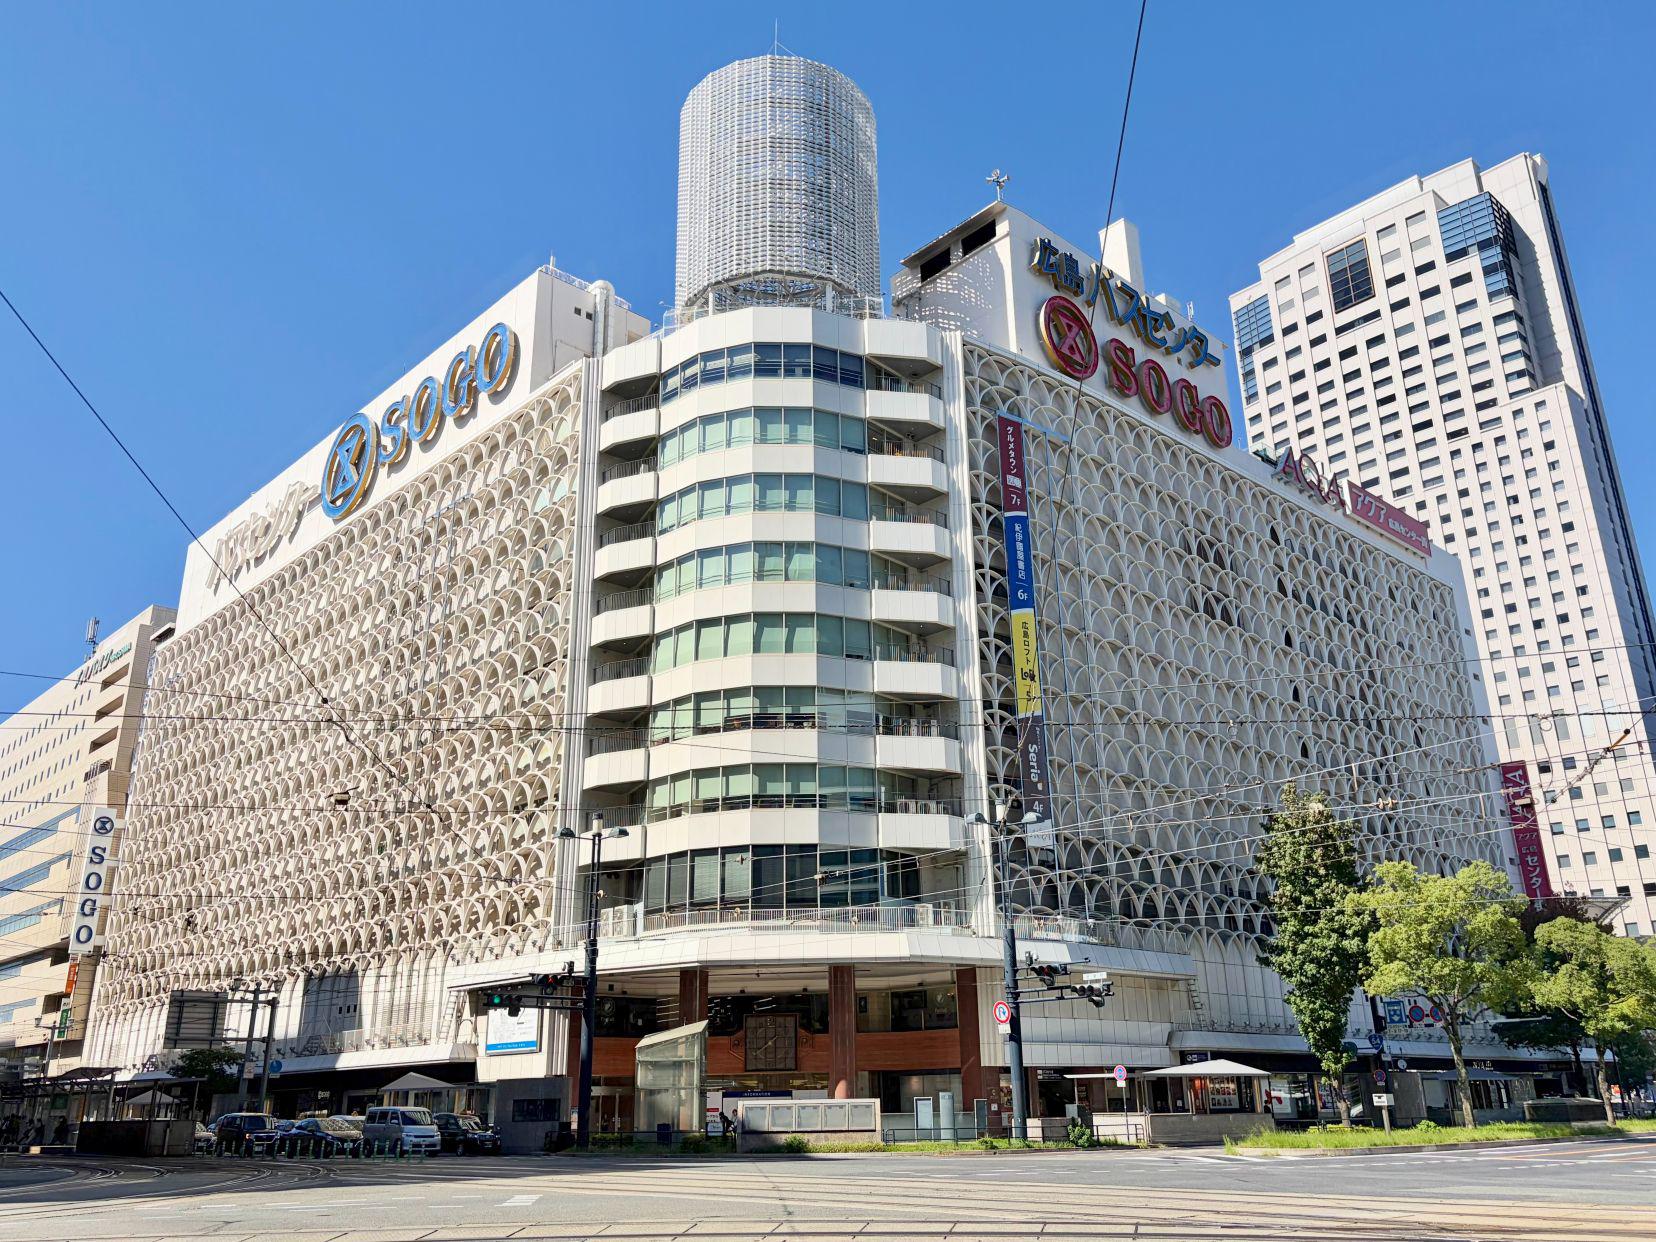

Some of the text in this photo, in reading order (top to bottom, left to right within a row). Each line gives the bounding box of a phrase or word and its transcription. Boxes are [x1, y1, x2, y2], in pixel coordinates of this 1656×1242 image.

[1030, 236, 1222, 370] 広島バスセンター
[379, 322, 516, 467] SOGO
[1104, 338, 1233, 449] SOGO
[1006, 426, 1017, 474] グルメタウン
[1010, 494, 1021, 506] 7F
[1352, 487, 1387, 523] アクア
[1017, 589, 1028, 600] 6F
[1021, 621, 1031, 665] 広島ロフト
[1028, 743, 1040, 783] Seria
[1032, 801, 1044, 813] 4F
[75, 846, 107, 944] SOGO
